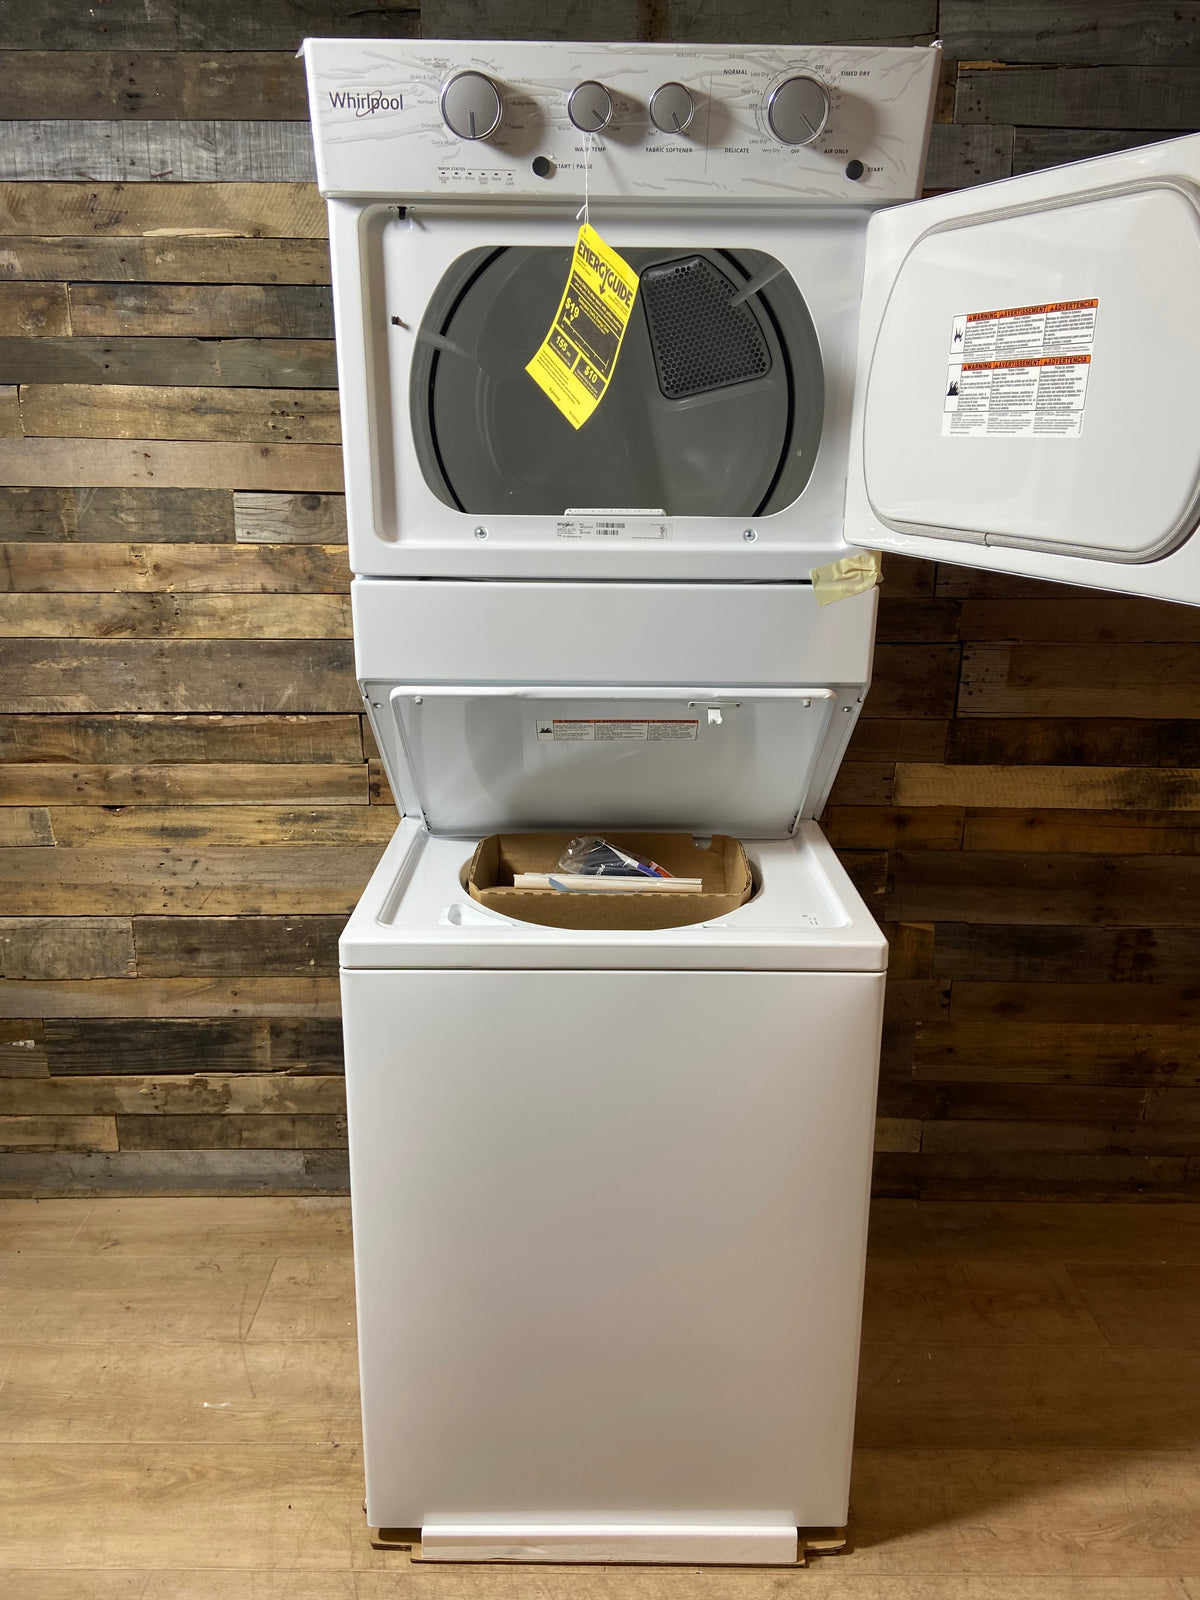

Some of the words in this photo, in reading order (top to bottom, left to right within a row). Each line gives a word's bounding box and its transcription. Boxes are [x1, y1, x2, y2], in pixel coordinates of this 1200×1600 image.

[329, 90, 404, 118] Whirlpool
[577, 238, 634, 309] ENERGYGUIDE
[564, 297, 580, 319] $19
[972, 311, 998, 321] WARNING
[1003, 305, 1047, 318] AVERTISSEMENT
[1054, 300, 1094, 311] ADVERTENCIA
[555, 335, 569, 352] 155
[967, 361, 992, 370] WARNING
[998, 358, 1041, 369] AVERTISSEMENT
[1047, 355, 1087, 366] ADVERTENCIA
[584, 365, 598, 384] $10
